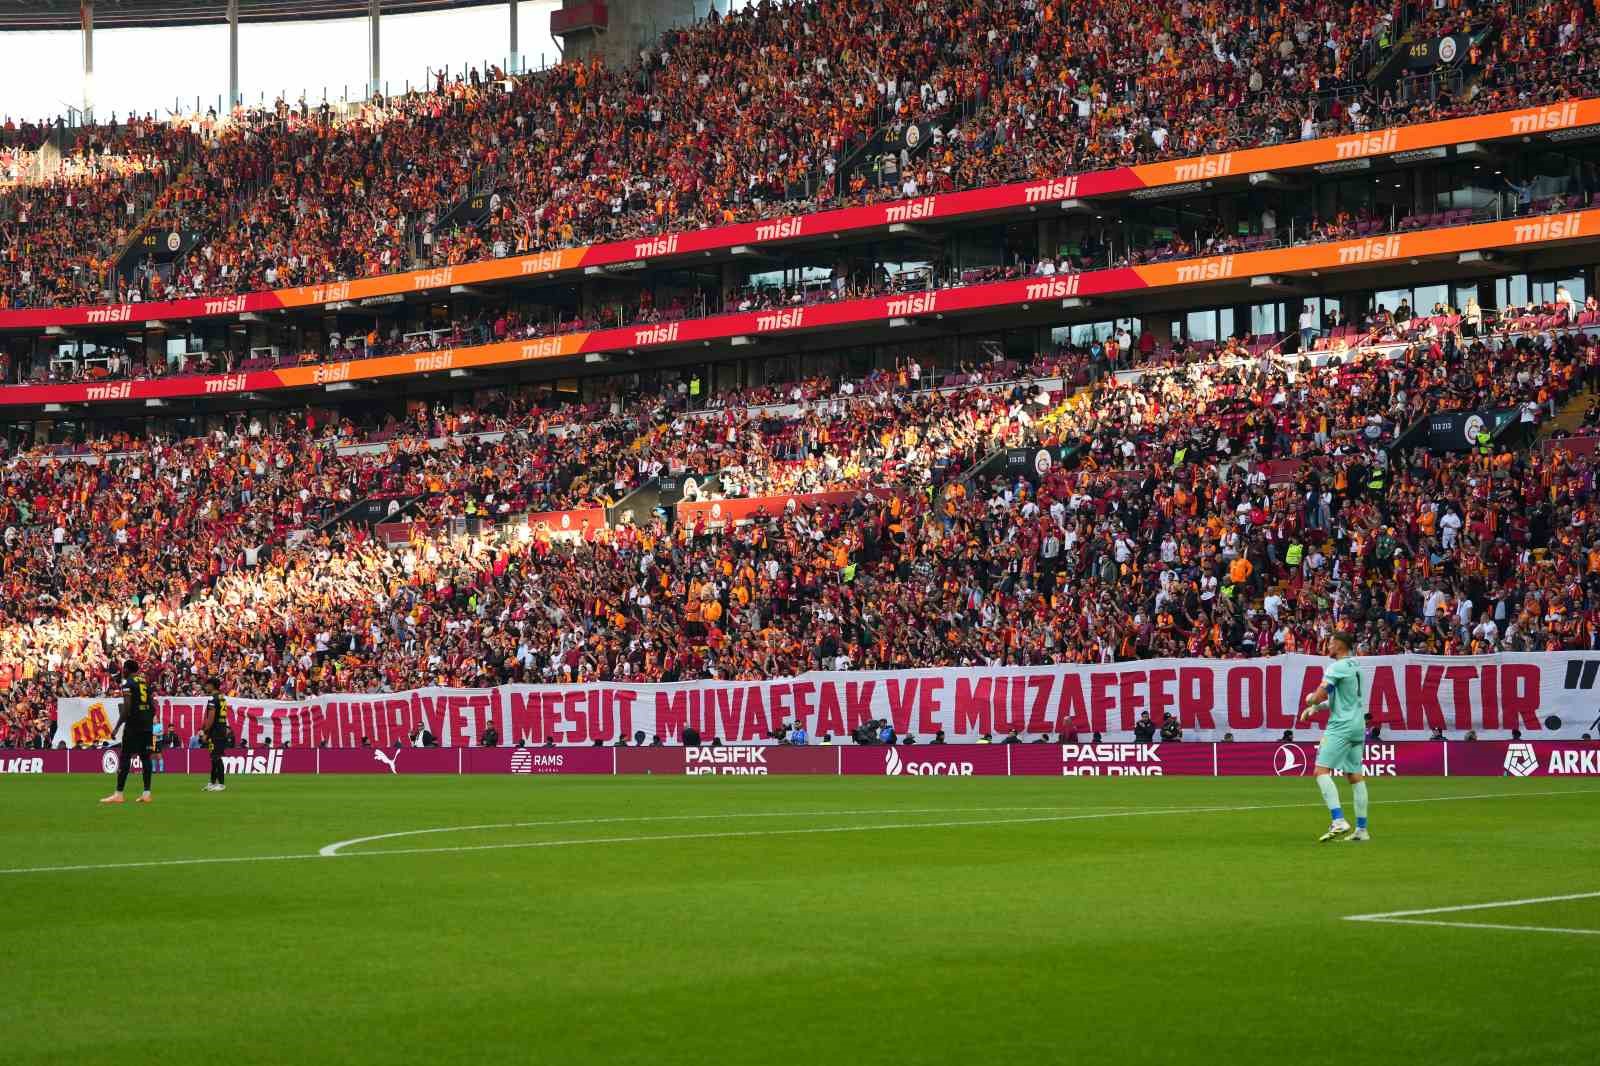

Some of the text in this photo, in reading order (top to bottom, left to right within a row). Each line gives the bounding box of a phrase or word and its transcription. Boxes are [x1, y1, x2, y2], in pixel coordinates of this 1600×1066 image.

[1409, 43, 1428, 57] 415
[87, 102, 1578, 323] misli misli misli misli misli misli misli misli misli misli misli misli
[87, 211, 1580, 400] misli misli misli misli misli misli misli misli misli misli misli misli
[511, 689, 638, 744] MESUT
[656, 679, 876, 743] MUVAFFAK
[886, 677, 944, 735] VE
[954, 667, 1216, 736] MUZAFFER
[221, 749, 283, 773] misli
[534, 755, 564, 766] RAMS
[907, 762, 974, 776] SOCAR
[1548, 750, 1600, 774] ARK
